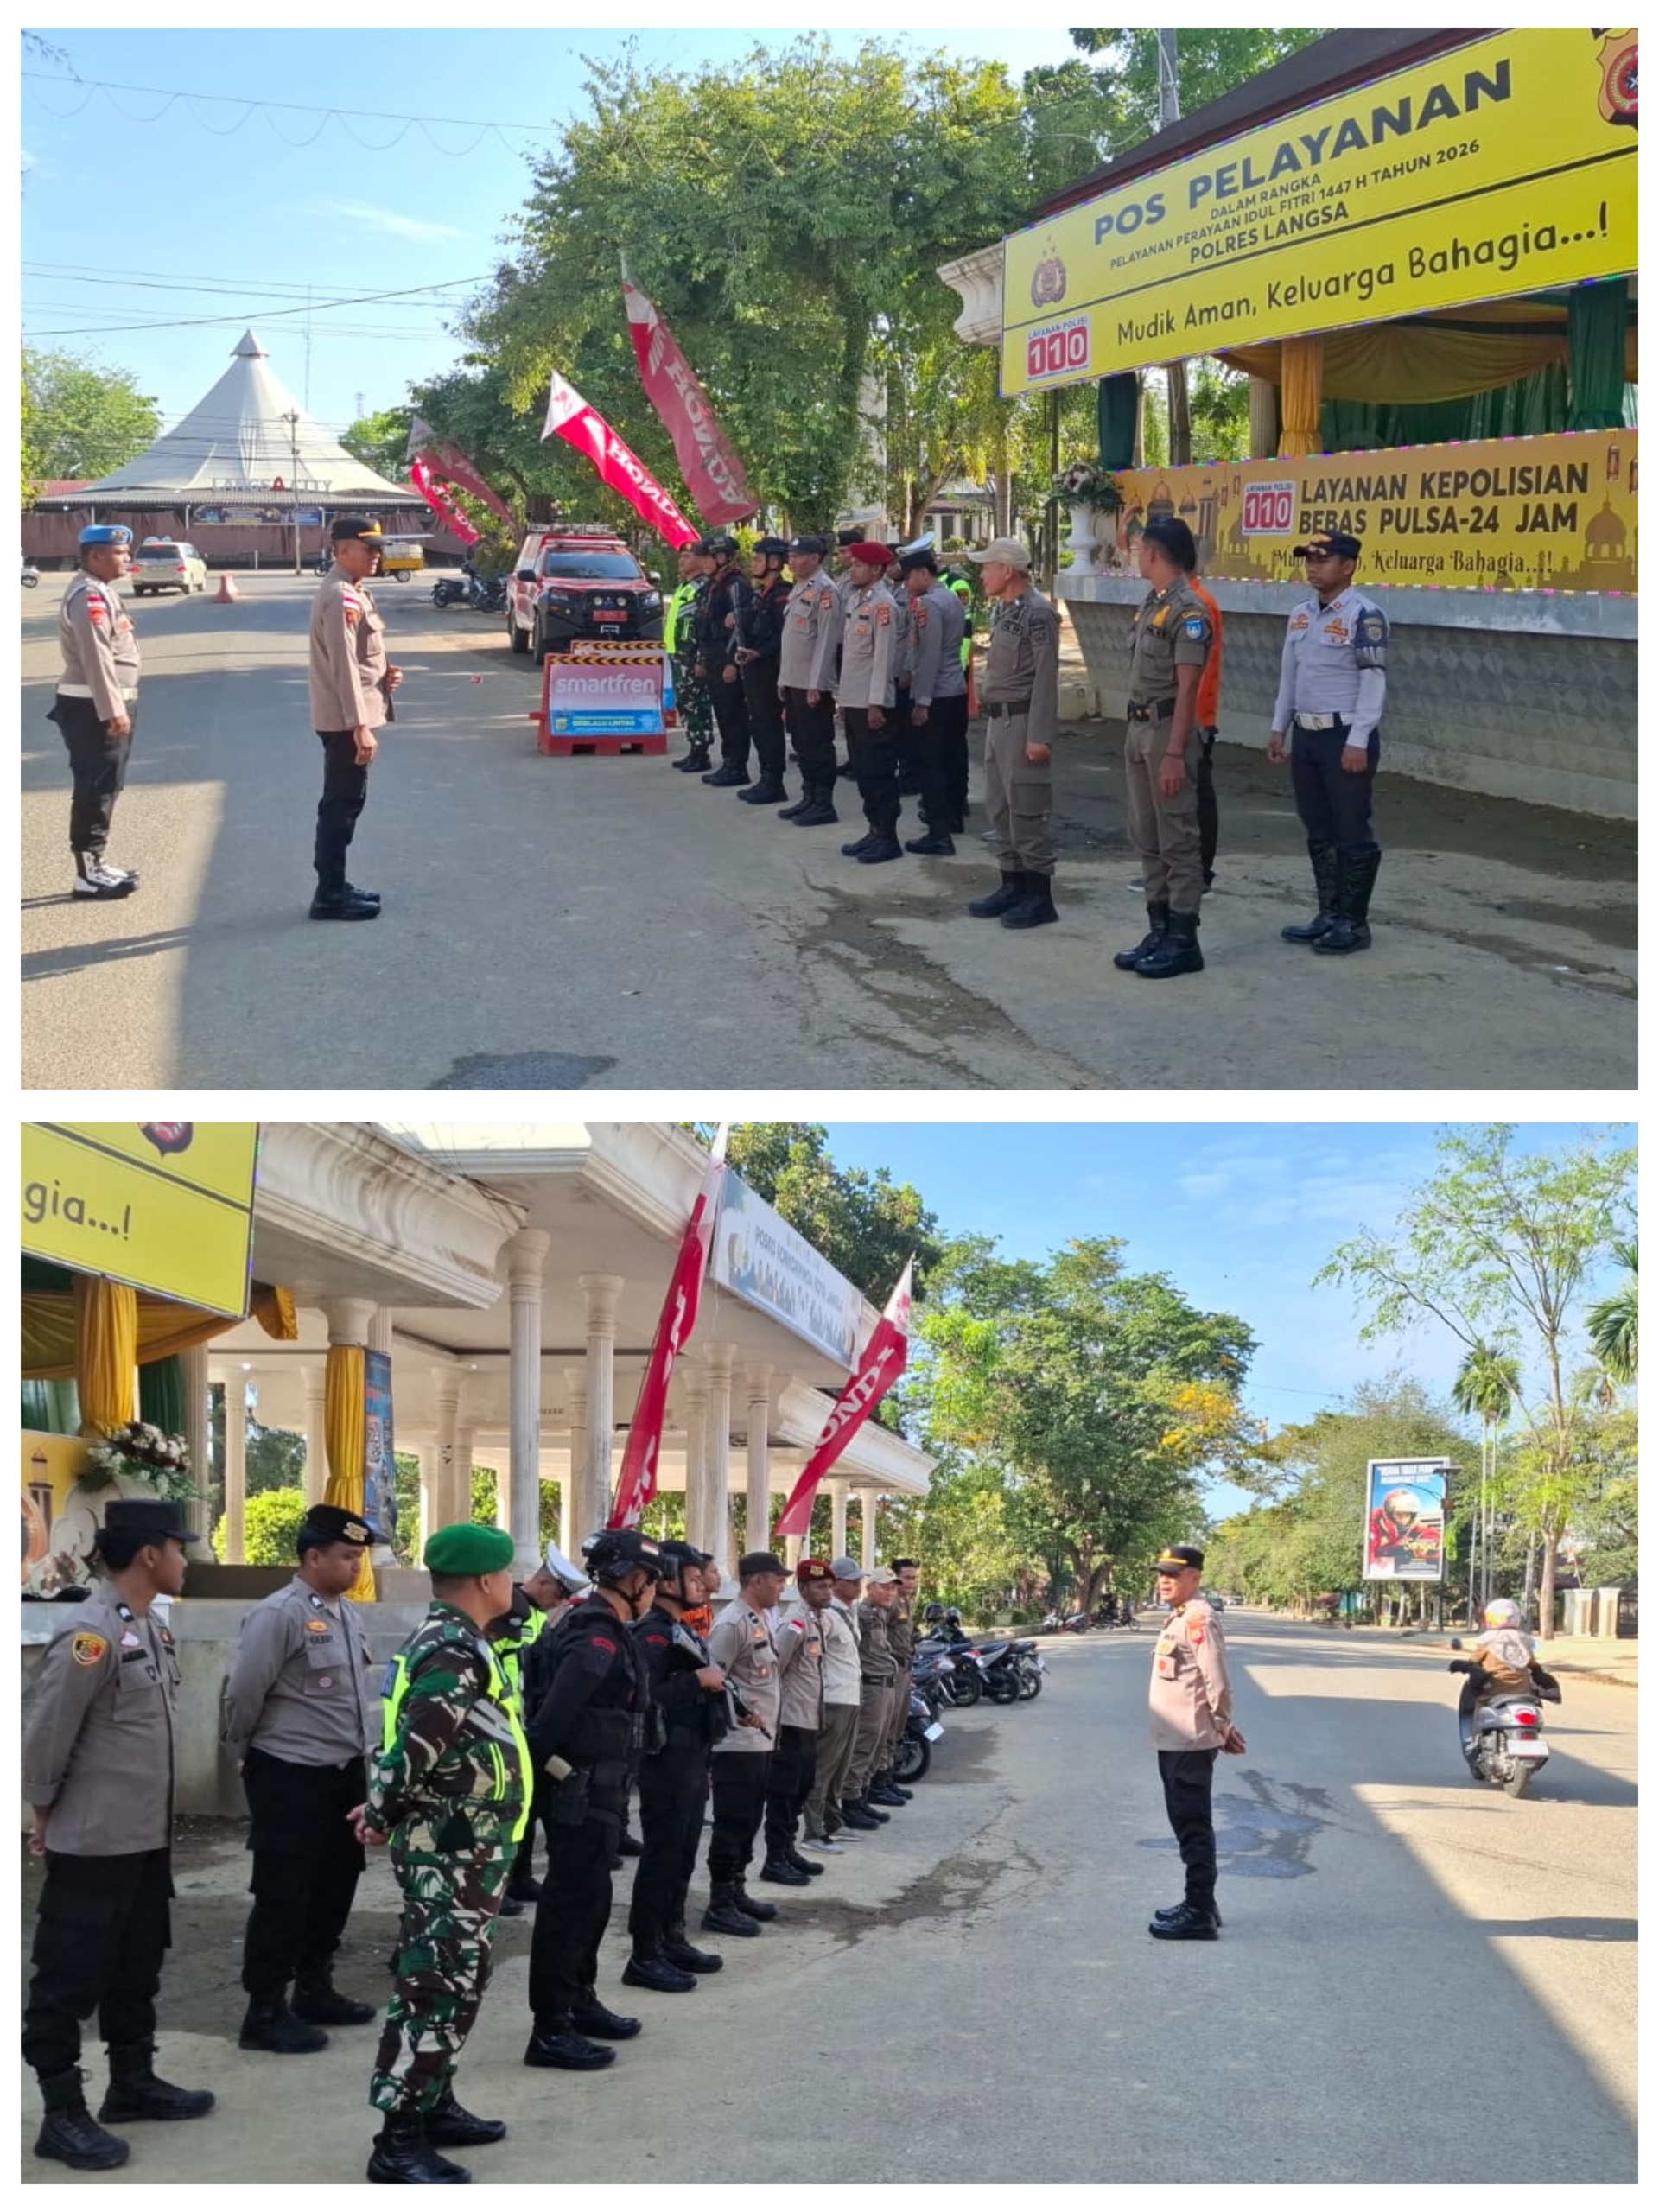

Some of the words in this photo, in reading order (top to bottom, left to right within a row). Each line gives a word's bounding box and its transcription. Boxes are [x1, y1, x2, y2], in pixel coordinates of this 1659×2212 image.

[1095, 193, 1166, 246] POS
[1189, 59, 1512, 210] PELAYANAN
[1110, 238, 1173, 270] PELAYANAN
[1176, 216, 1241, 247] PERAYAAN
[1244, 206, 1275, 226] IDUL
[1280, 192, 1316, 213] FITRI
[1319, 180, 1351, 200] 1447
[1356, 175, 1367, 189] H
[1371, 154, 1431, 183] TAHUN
[1436, 139, 1480, 164] 2026
[1211, 195, 1255, 220] DALAM
[1260, 173, 1321, 203] RANGKA
[1191, 228, 1258, 264] POLRES
[1264, 201, 1348, 241] LANGSA
[1118, 309, 1175, 345] Mudik
[1184, 297, 1256, 330] Aman,
[1268, 262, 1395, 310] Keluarga
[1029, 331, 1086, 372] 110
[1301, 474, 1407, 504] LAYANAN
[1420, 462, 1589, 499] KEPOLISIAN
[1246, 496, 1290, 524] 110
[1299, 509, 1367, 534] BEBAS
[1380, 505, 1499, 534] PULSA-24
[1515, 502, 1578, 533] JAM
[1371, 549, 1444, 575] Keluarga
[556, 674, 655, 695] smartfren
